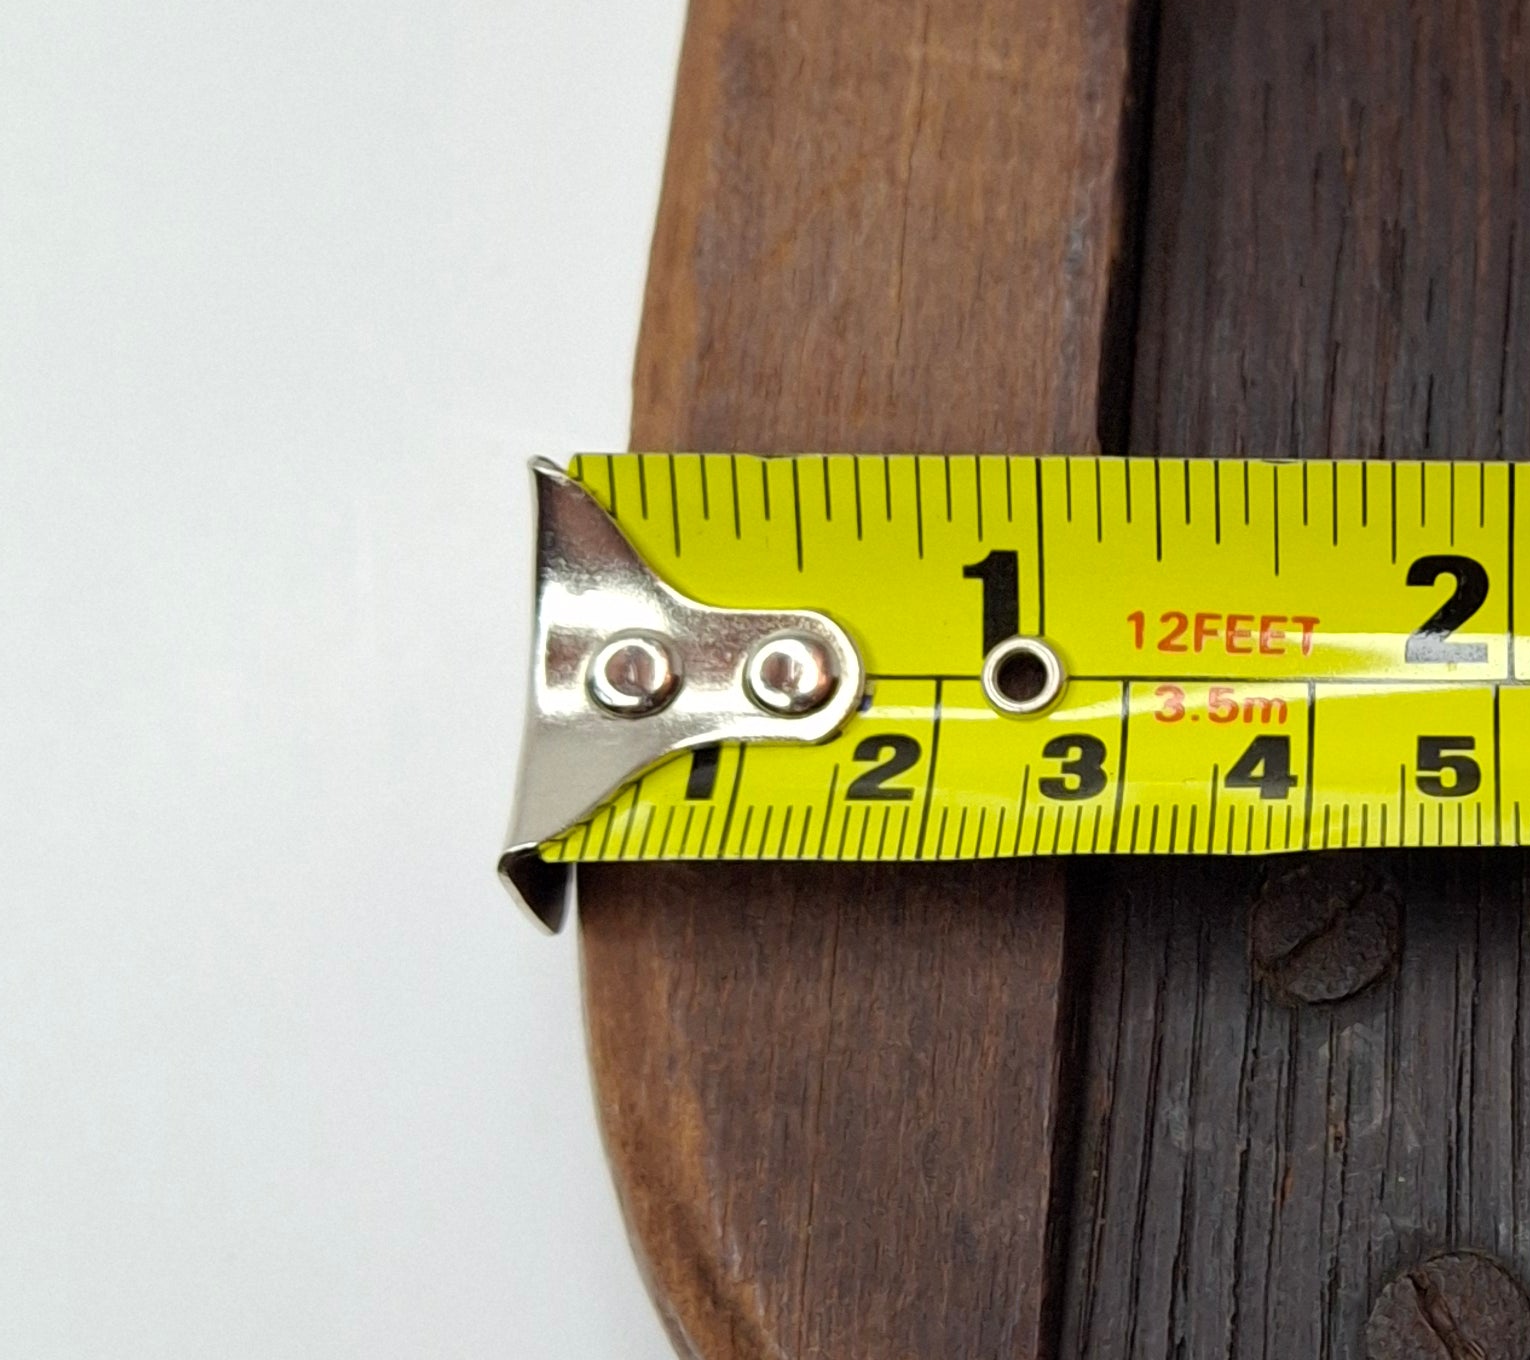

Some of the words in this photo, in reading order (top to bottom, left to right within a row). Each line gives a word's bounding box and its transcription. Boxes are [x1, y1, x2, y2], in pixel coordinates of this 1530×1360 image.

[963, 549, 1020, 660] 1
[1404, 553, 1490, 664] 2
[1126, 611, 1321, 657] 12FEET
[1153, 684, 1289, 725] 3.5m
[684, 741, 722, 800] 1
[844, 733, 922, 801] 2
[1037, 734, 1108, 801] 3
[1223, 734, 1298, 800] 4
[1414, 735, 1482, 798] 5
